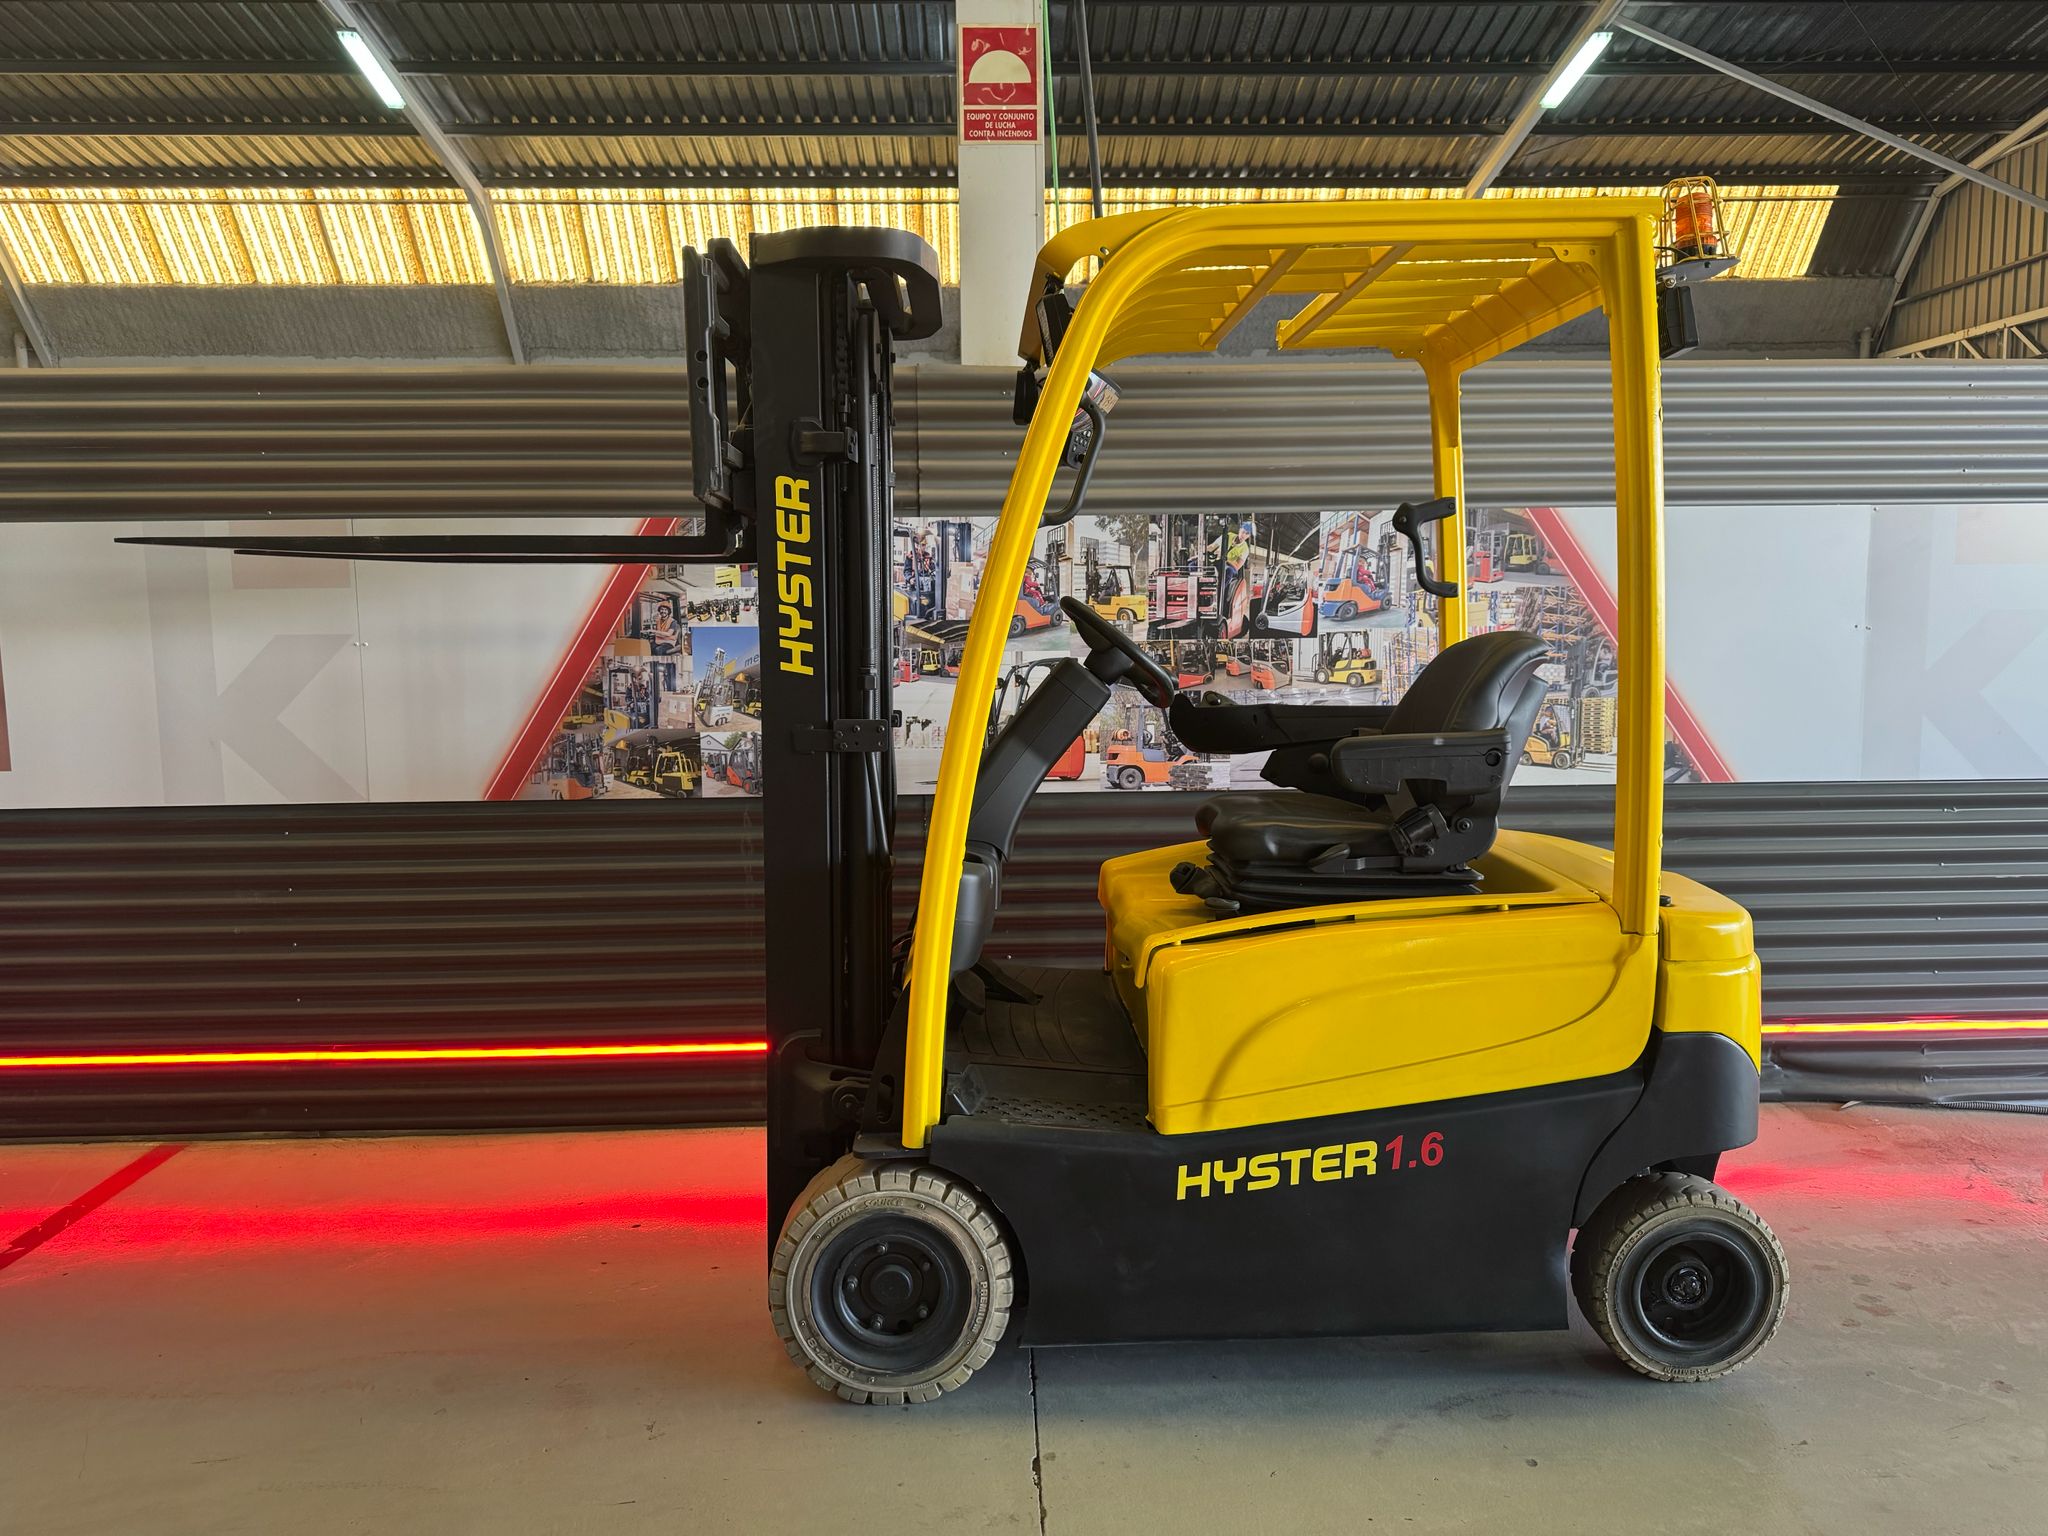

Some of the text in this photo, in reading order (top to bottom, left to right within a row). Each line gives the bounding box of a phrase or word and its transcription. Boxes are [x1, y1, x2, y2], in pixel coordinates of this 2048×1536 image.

[966, 112, 991, 120] EQUIPO
[998, 112, 1035, 120] CONJUNTO
[985, 121, 1016, 129] DE LUCHA
[968, 129, 1033, 137] CONTRA INCENDIOS
[775, 475, 814, 675] HYSTER
[1176, 1131, 1445, 1201] HYSTER 1.6
[972, 1281, 988, 1333] PREMIUM
